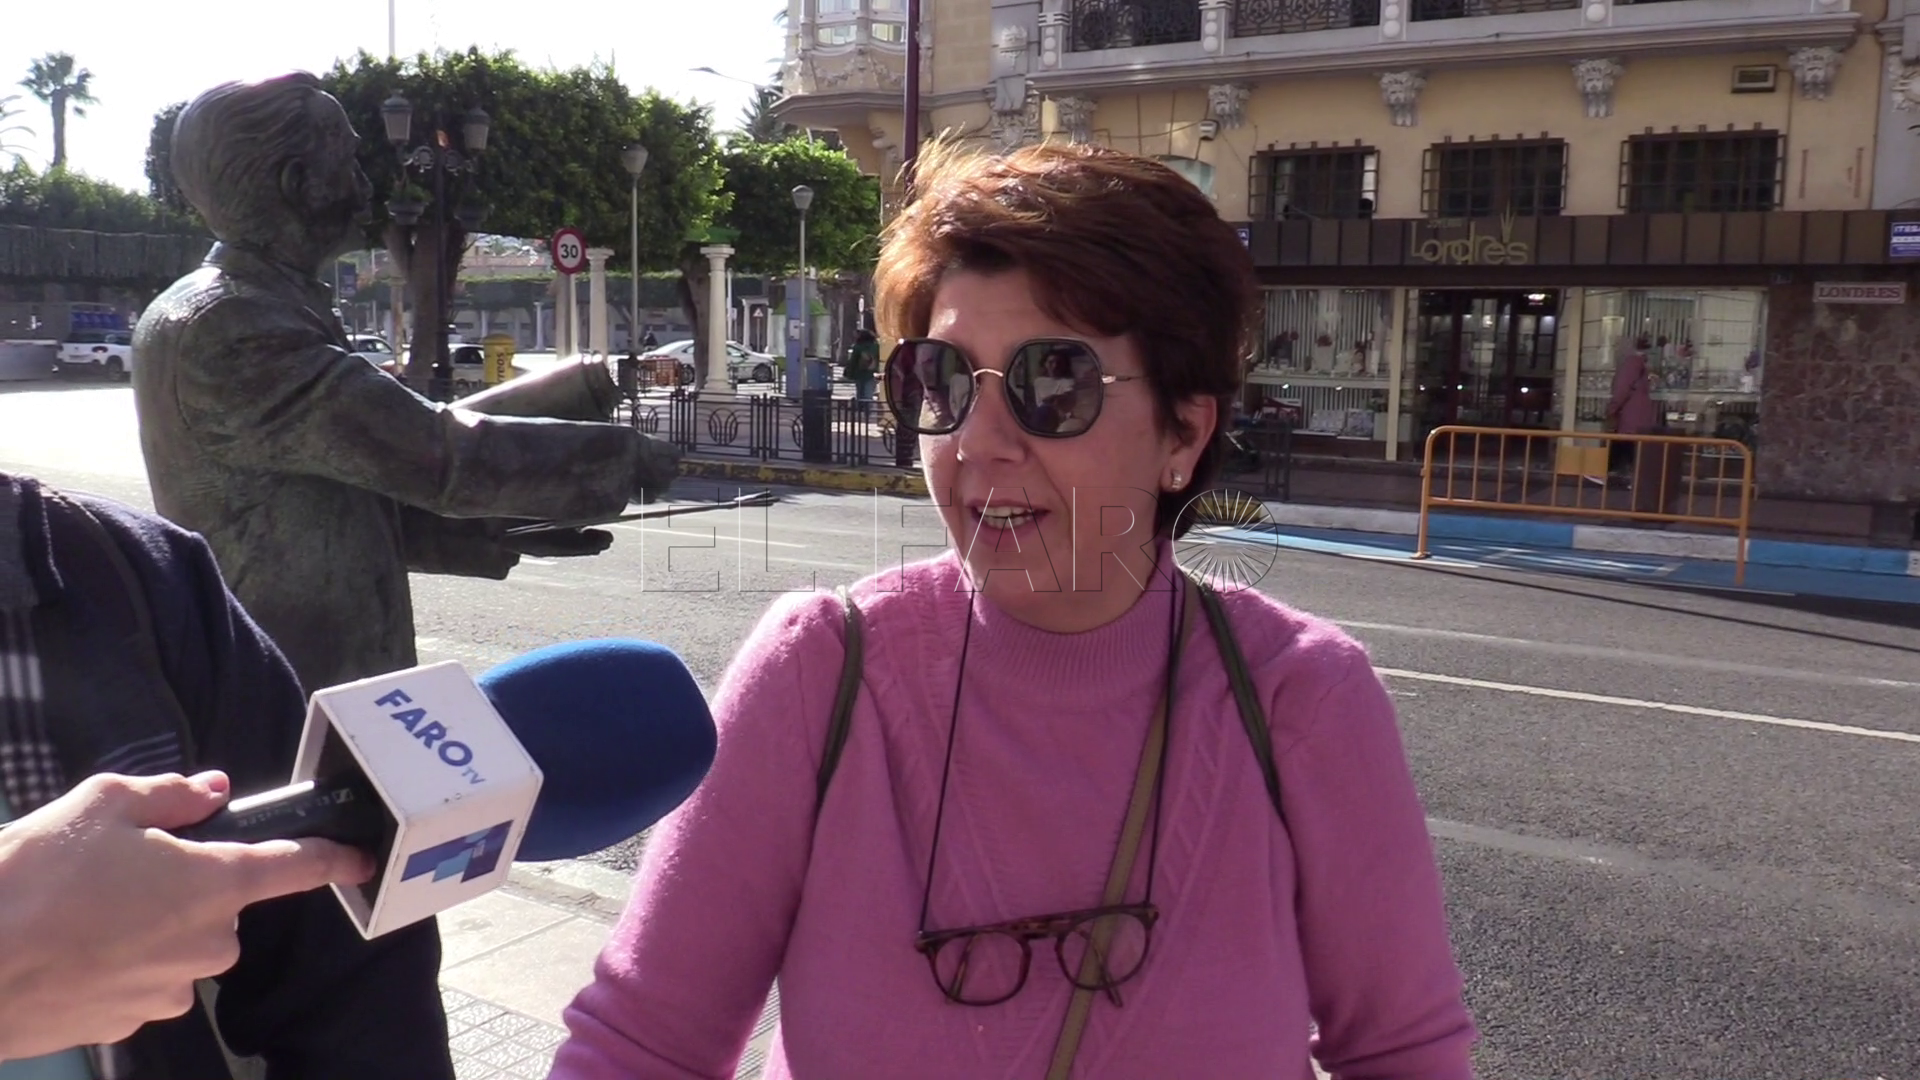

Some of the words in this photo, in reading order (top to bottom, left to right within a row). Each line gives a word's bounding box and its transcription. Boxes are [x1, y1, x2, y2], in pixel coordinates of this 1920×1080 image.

[560, 243, 579, 259] 30
[1411, 221, 1528, 265] Londres
[1818, 286, 1900, 298] LONDRES
[374, 688, 473, 767] FARO
[461, 766, 487, 785] TV
